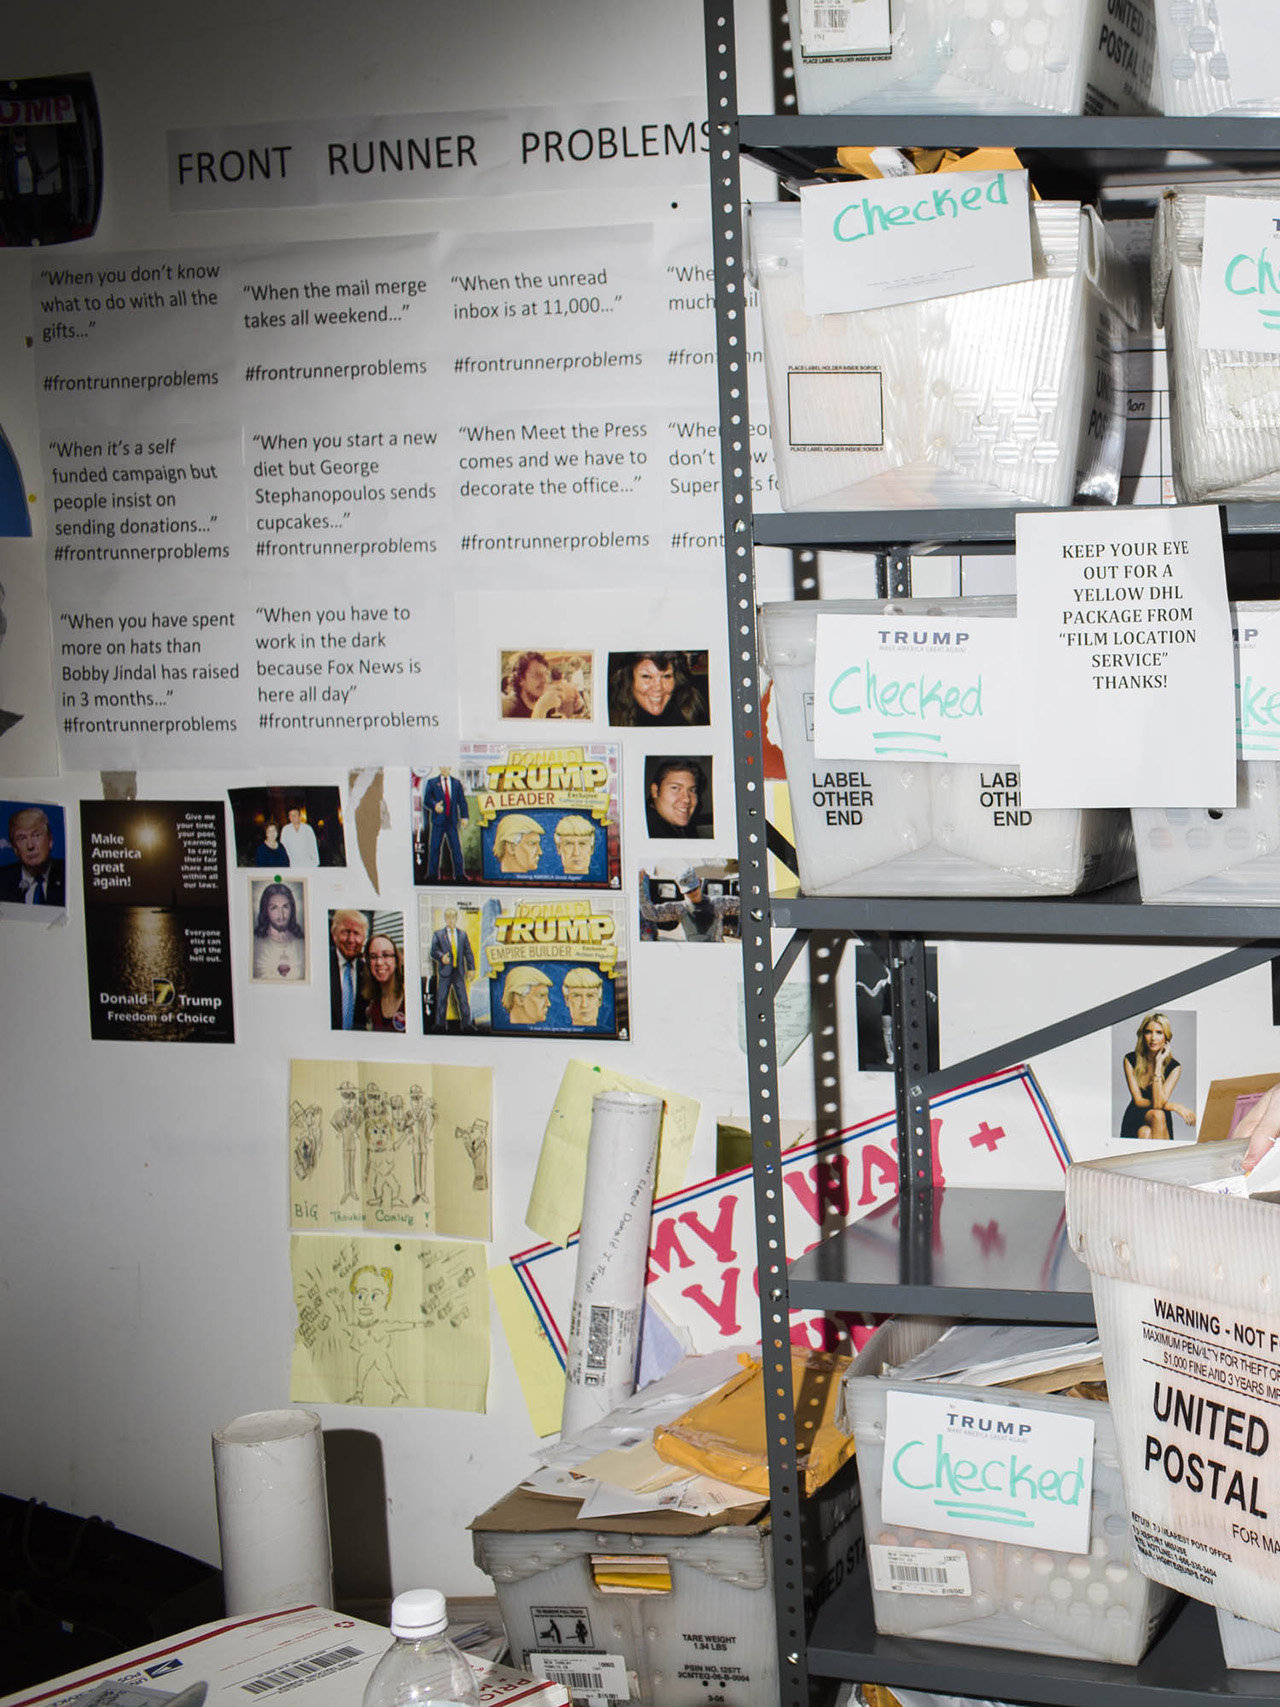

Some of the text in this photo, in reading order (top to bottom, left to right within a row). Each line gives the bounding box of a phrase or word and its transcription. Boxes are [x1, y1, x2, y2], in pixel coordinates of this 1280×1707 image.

[1100, 25, 1138, 78] POSTAL
[178, 146, 292, 185] FRONT
[328, 135, 477, 175] RUNNER
[830, 170, 1008, 242] Checked
[41, 264, 220, 286] “When you don’t know
[451, 268, 607, 291] “When the unread
[243, 280, 426, 301] “When the mail merge
[41, 289, 217, 312] what to do with all the
[244, 312, 286, 328] takes
[291, 310, 308, 326] all
[454, 303, 498, 319] inbox
[505, 302, 516, 317] is
[522, 302, 537, 316] at
[245, 359, 426, 381] #frontrunnerproblems
[454, 352, 642, 373] #frontrunnerproblems
[43, 370, 218, 391] #frontrunnerproblems
[253, 433, 437, 451] “When you start a new
[254, 460, 378, 477] diet but George
[256, 483, 436, 506] Stephanopoulos sends
[256, 538, 436, 557] #frontrunnerproblems
[1063, 541, 1188, 558] KEEP YOUR EYE
[1084, 564, 1172, 579] OUT FOR A
[1074, 586, 1183, 602] YELLOW DHL
[1064, 608, 1192, 624] PACKAGE FROM
[878, 631, 969, 645] TRUMP
[1060, 630, 1195, 646] “FILM LOCATION
[1092, 652, 1168, 667] SERVICE”
[829, 659, 983, 720] Checked
[1093, 675, 1166, 689] THANKS!
[488, 762, 609, 790] TRUMP
[813, 772, 871, 787] LABEL
[980, 772, 1020, 788] LAB
[485, 795, 495, 808] A
[501, 792, 555, 806] LEADER
[813, 791, 873, 807] OTHER
[980, 791, 1021, 807] OTH
[826, 810, 862, 825] END
[994, 811, 1032, 826] END
[91, 833, 124, 844] Make
[92, 848, 141, 859] America
[93, 863, 124, 875] great
[93, 876, 131, 889] again!
[185, 929, 220, 938] Everyone
[496, 915, 615, 944] TRUMP
[490, 946, 526, 960] EMPIRE
[529, 945, 571, 957] BUILDER
[100, 993, 221, 1009] Donald Trump
[108, 1011, 215, 1023] Freedom of Choice
[647, 1196, 738, 1286] MY
[1154, 1298, 1220, 1336] WARNING
[1234, 1323, 1265, 1349] NOT
[947, 1413, 1031, 1436] TRUMP
[1154, 1382, 1268, 1457] UNITED
[892, 1434, 1084, 1509] Checked
[1145, 1435, 1268, 1519] POSTAL
[1232, 1523, 1260, 1547] FOR
[682, 1634, 736, 1644] TARE WEIGHT
[684, 1664, 702, 1673] PSIN
